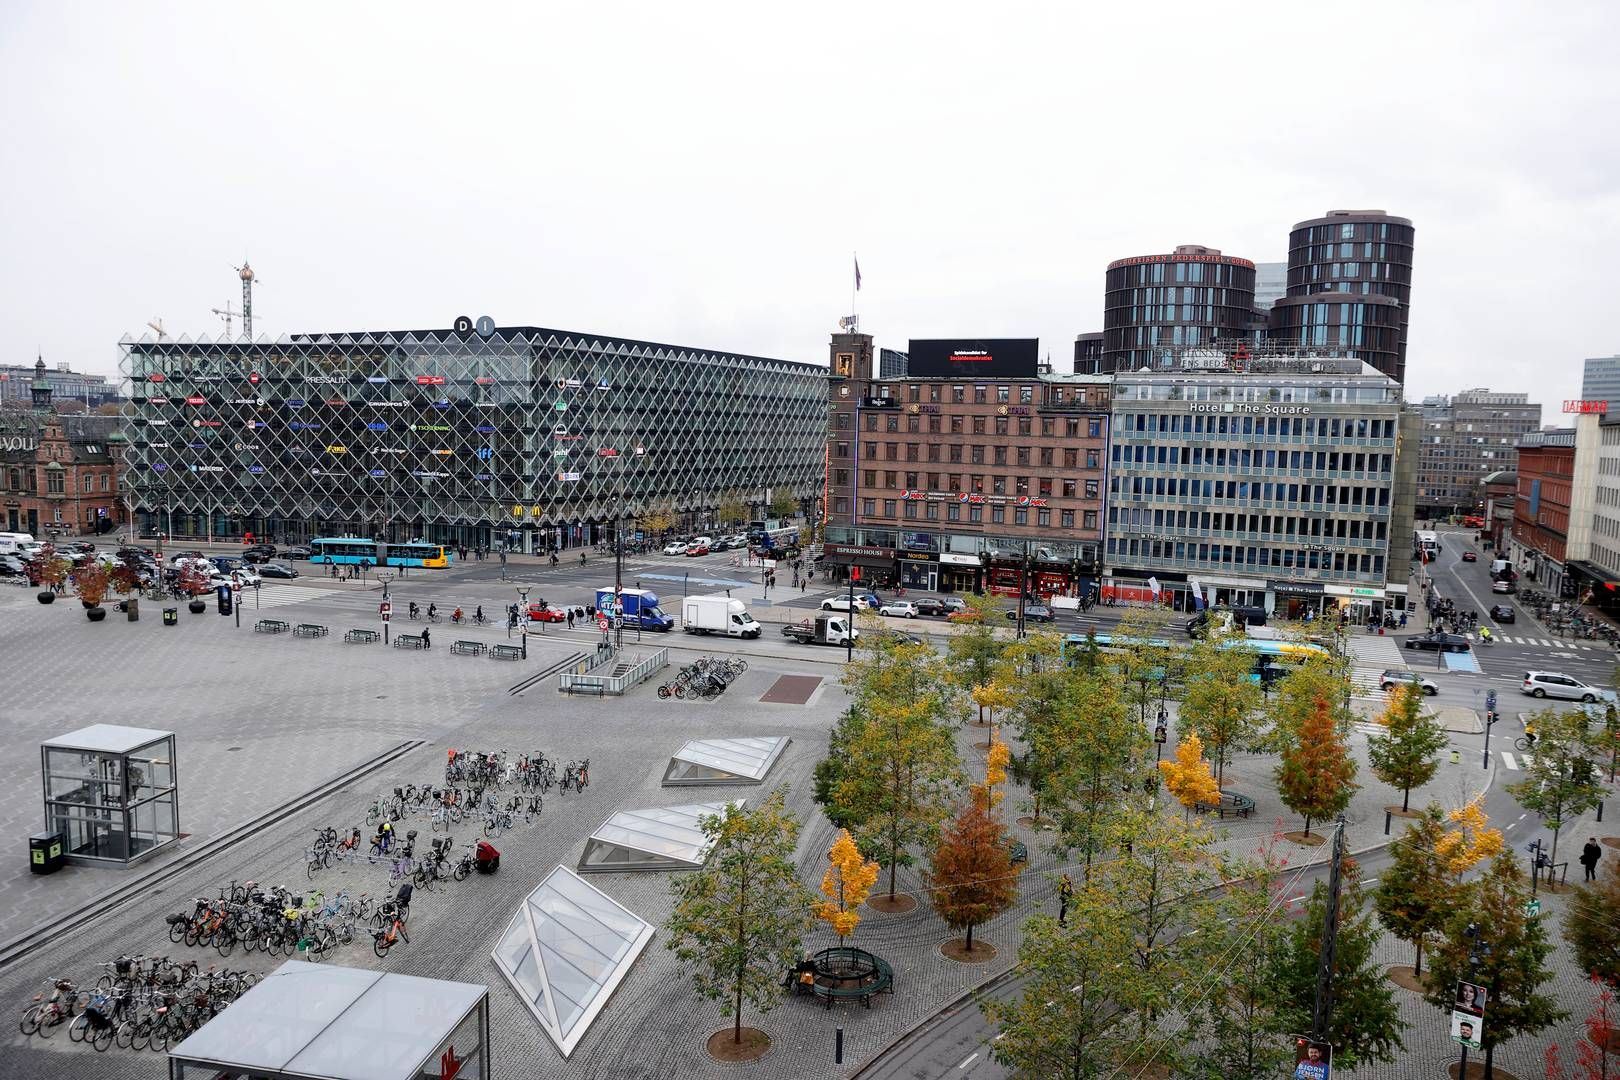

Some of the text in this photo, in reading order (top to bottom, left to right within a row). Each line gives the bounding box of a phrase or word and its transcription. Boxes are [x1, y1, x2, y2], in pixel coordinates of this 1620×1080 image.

[1189, 403, 1310, 415] Hotel The Square
[836, 547, 863, 555] ESPRESSO
[907, 552, 929, 560] Nordea
